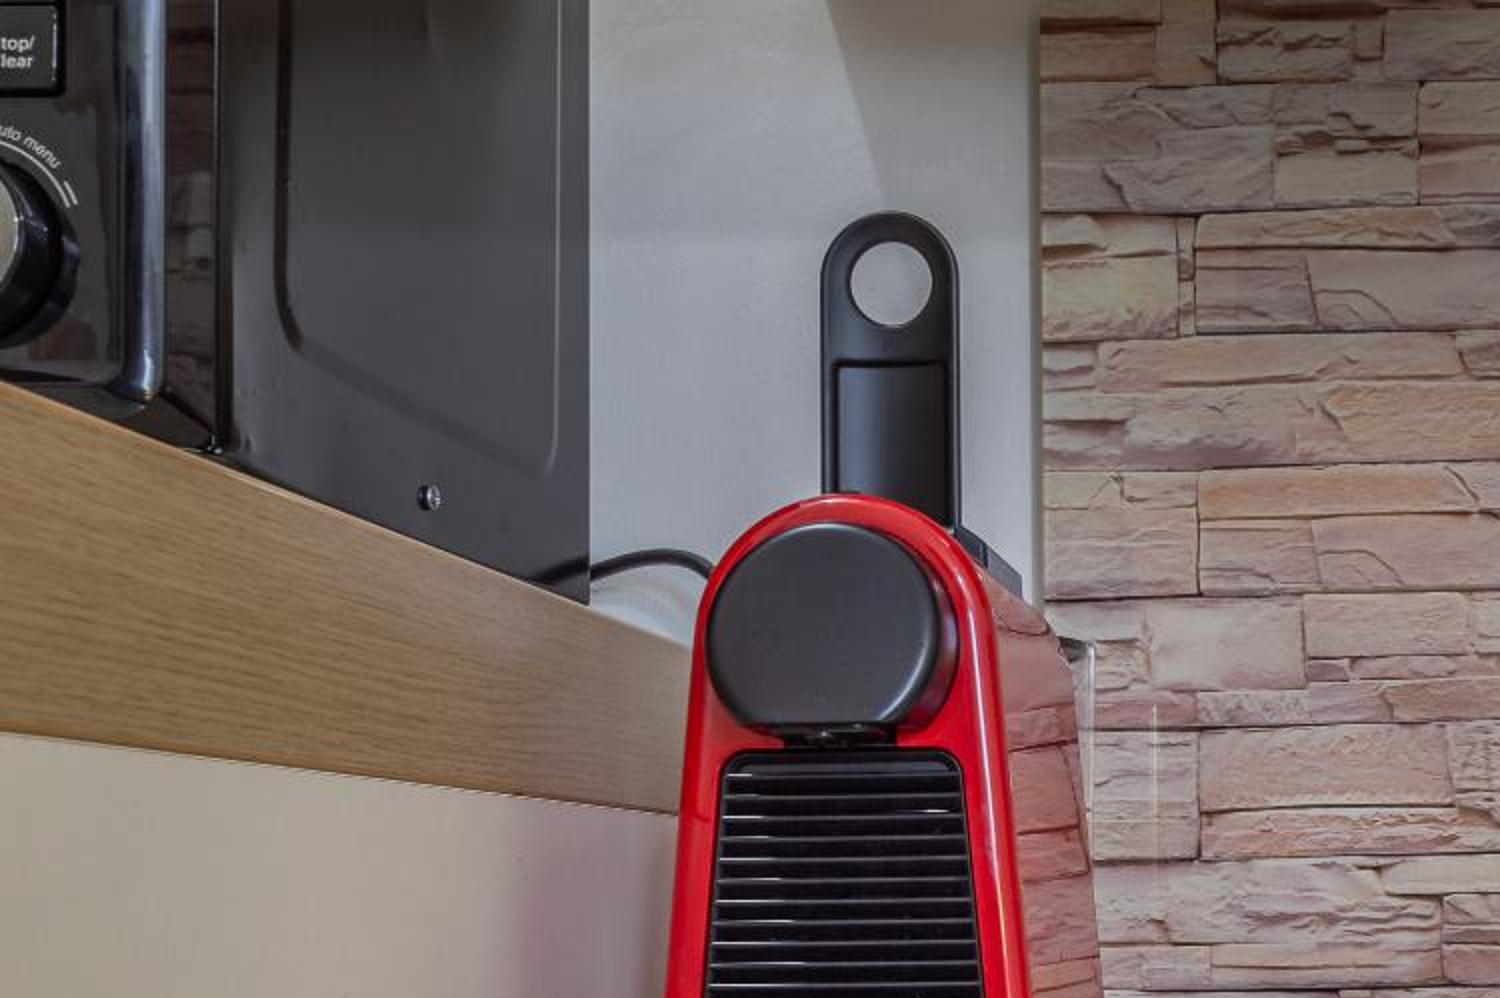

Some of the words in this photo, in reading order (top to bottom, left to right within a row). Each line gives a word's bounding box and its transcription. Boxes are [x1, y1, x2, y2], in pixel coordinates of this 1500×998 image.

[0, 34, 35, 53] top/
[0, 53, 33, 69] lear
[0, 125, 22, 141] uto
[23, 136, 61, 169] menu
